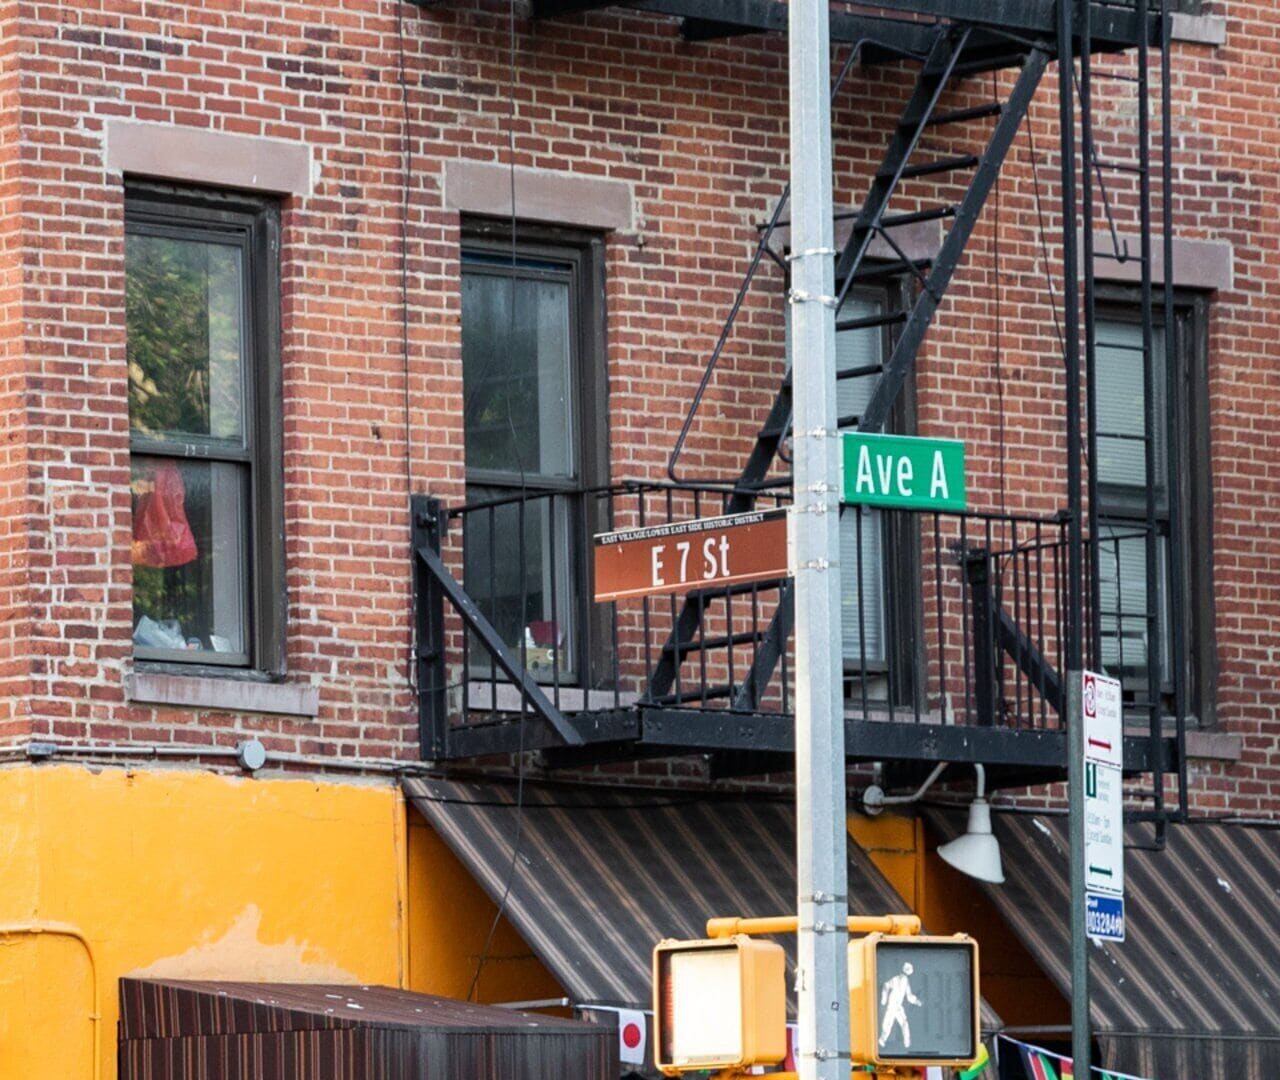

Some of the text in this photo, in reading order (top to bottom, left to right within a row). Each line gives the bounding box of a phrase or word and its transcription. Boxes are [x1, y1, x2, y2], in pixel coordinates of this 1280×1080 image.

[855, 444, 949, 499] Ave A
[671, 525, 687, 535] EAST
[651, 535, 730, 587] E 7 St
